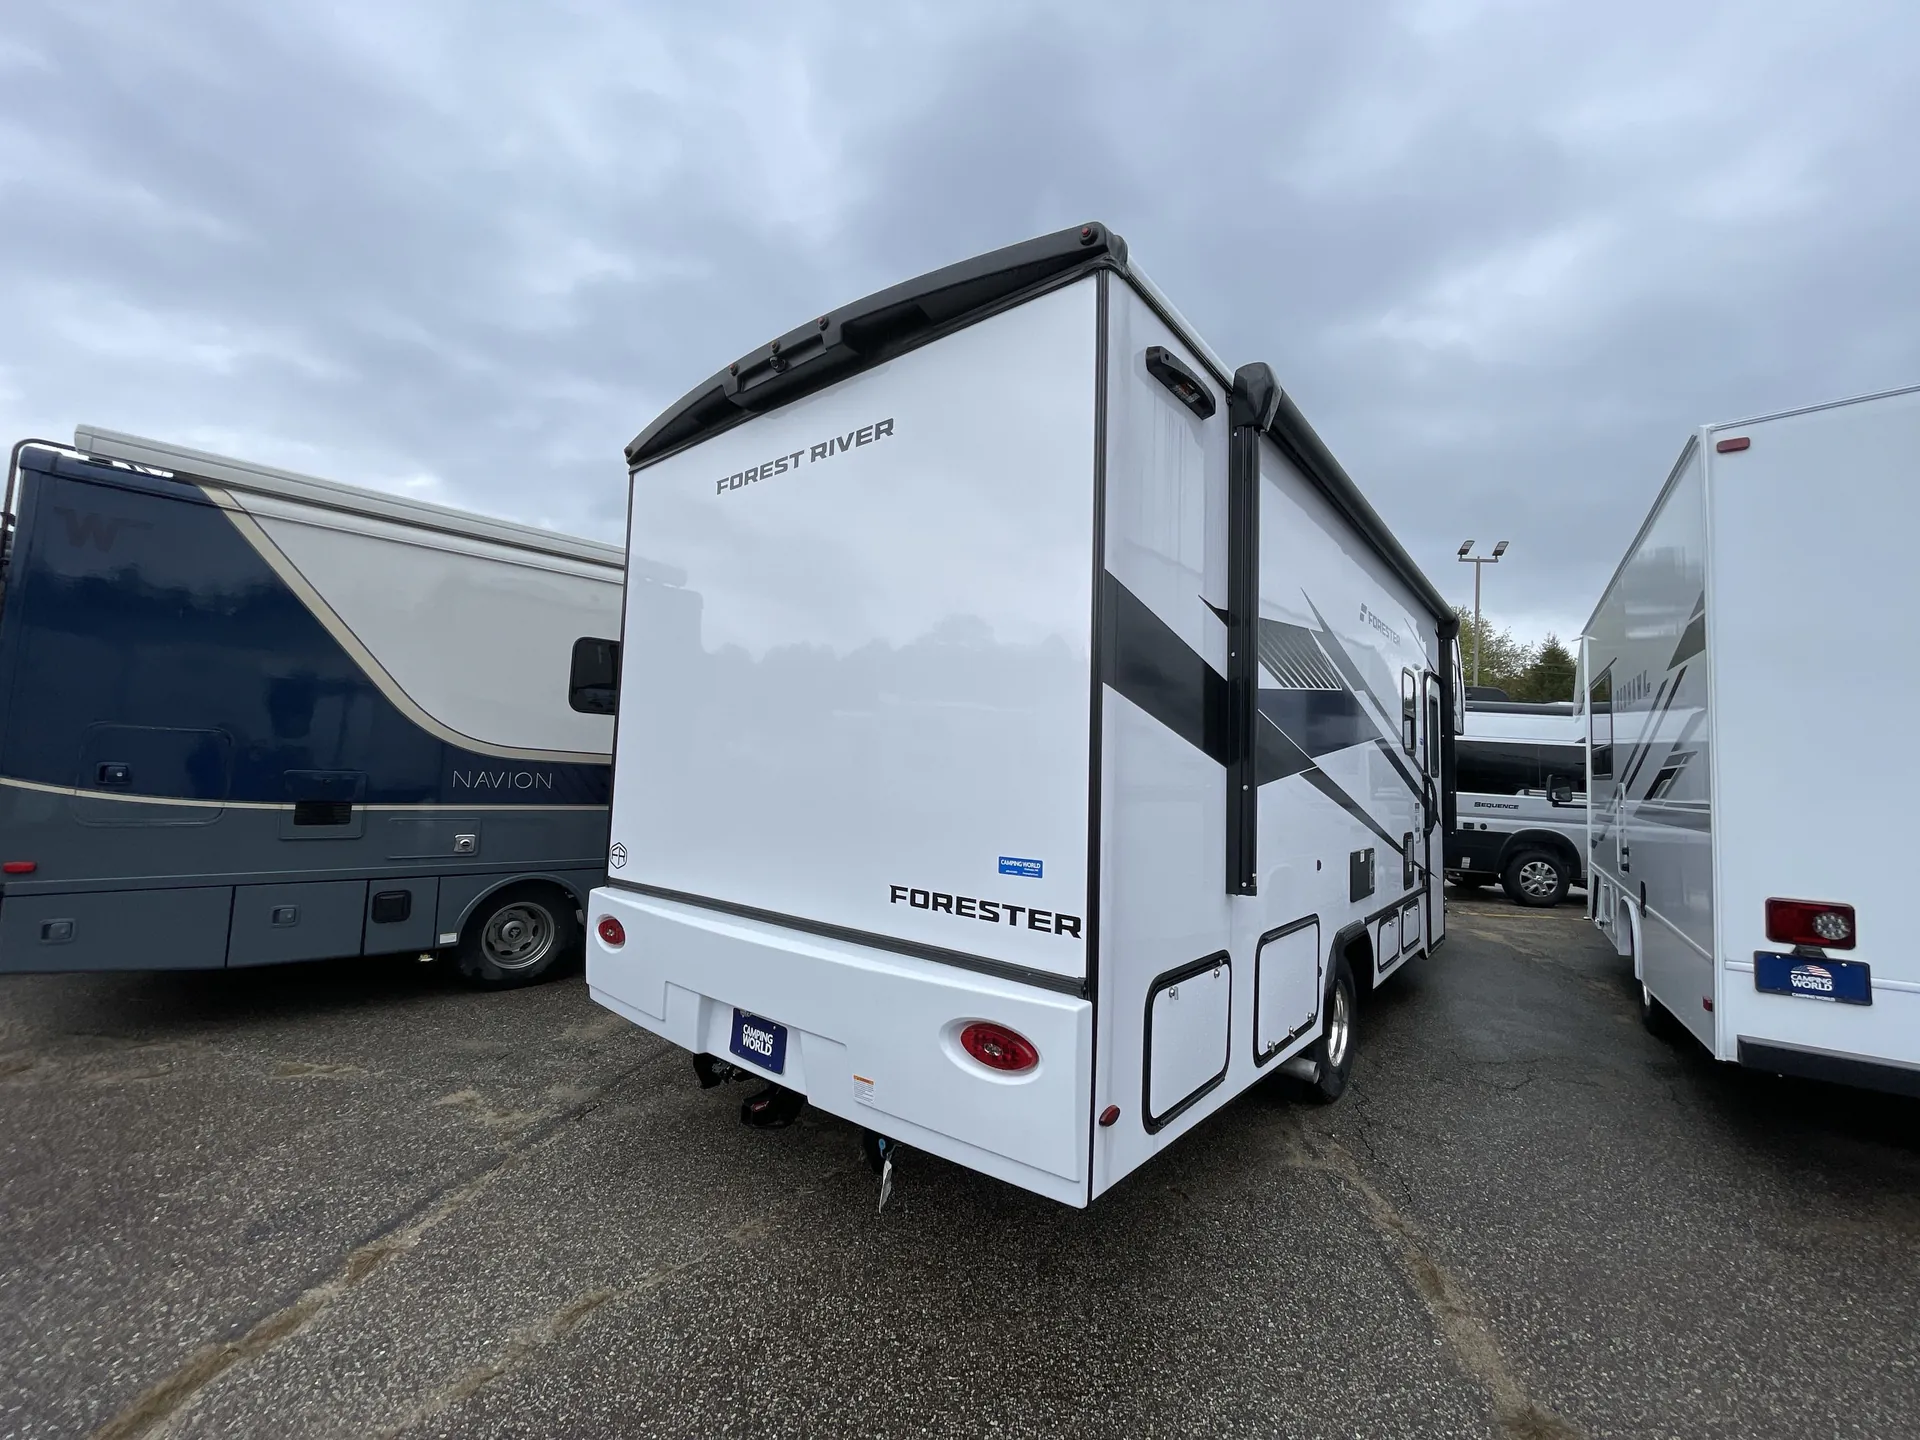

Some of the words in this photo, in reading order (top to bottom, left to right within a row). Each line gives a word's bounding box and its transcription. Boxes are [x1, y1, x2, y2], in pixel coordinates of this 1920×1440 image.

[716, 449, 805, 495] FOREST
[810, 418, 894, 464] RIVER
[1368, 610, 1401, 647] FORESTER
[452, 770, 552, 789] NAVION
[1474, 801, 1519, 810] SEQUENCE
[1001, 859, 1022, 868] CAMPING
[889, 884, 1082, 939] FORESTER
[1790, 974, 1833, 985] CAMPING
[1790, 980, 1833, 991] WORLD
[1791, 992, 1815, 1000] CAMPING
[743, 1024, 773, 1045] CAMPING
[742, 1033, 772, 1056] WORLD
